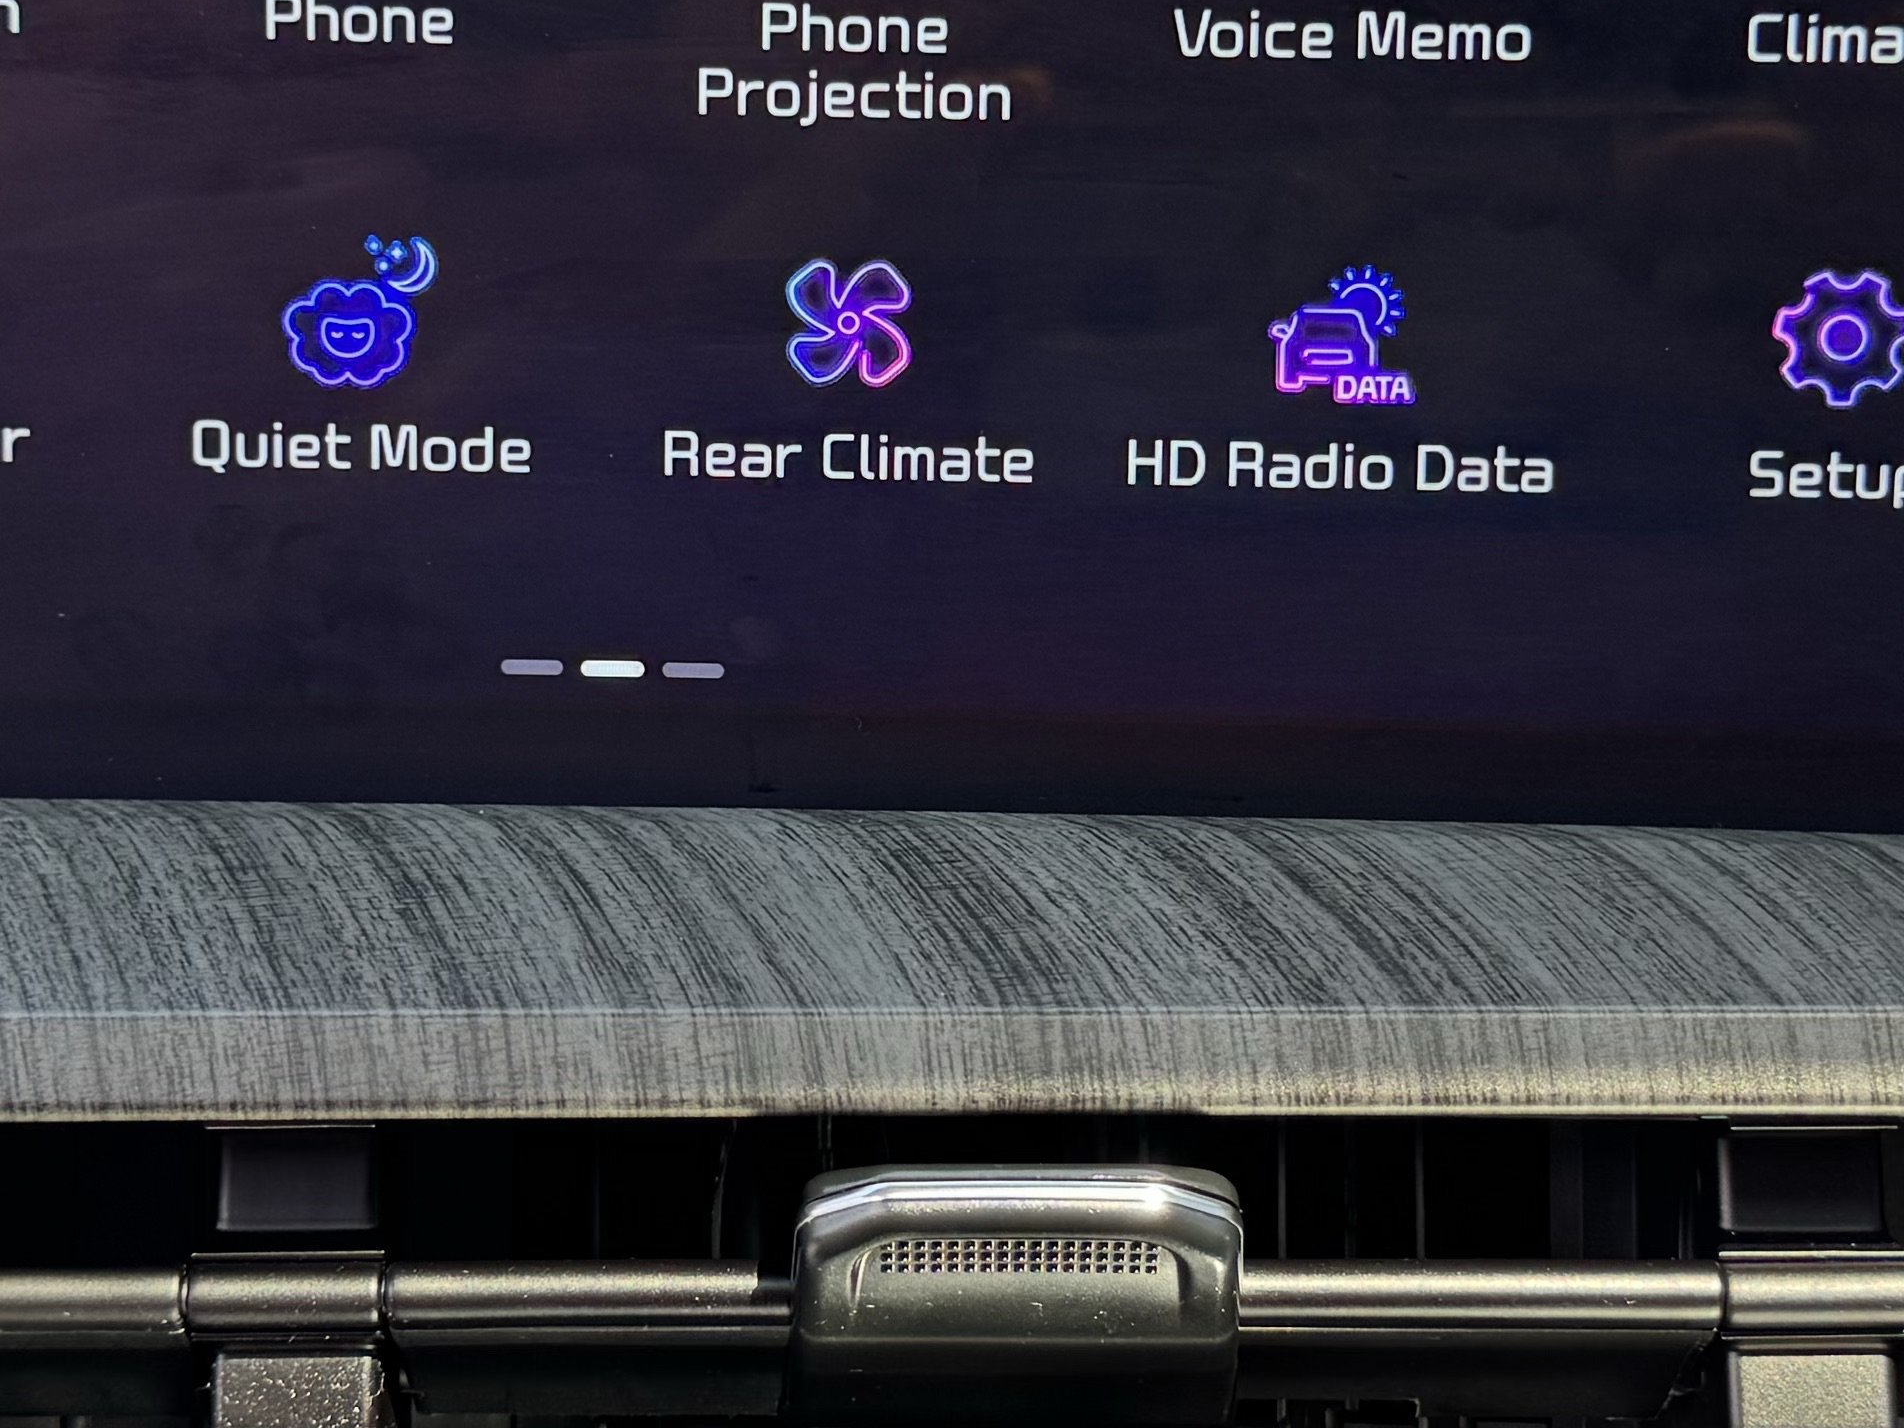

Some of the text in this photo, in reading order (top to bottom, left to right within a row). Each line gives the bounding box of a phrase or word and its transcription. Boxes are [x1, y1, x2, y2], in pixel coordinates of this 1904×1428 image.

[762, 3, 947, 53] Phone
[1174, 9, 1531, 60] Voice Memo
[699, 68, 1010, 126] Projection
[1337, 374, 1413, 401] DATA
[193, 420, 530, 473] Quiet Mode
[665, 431, 1033, 483] Rear Climate
[1128, 439, 1553, 493] HD Radio Data
